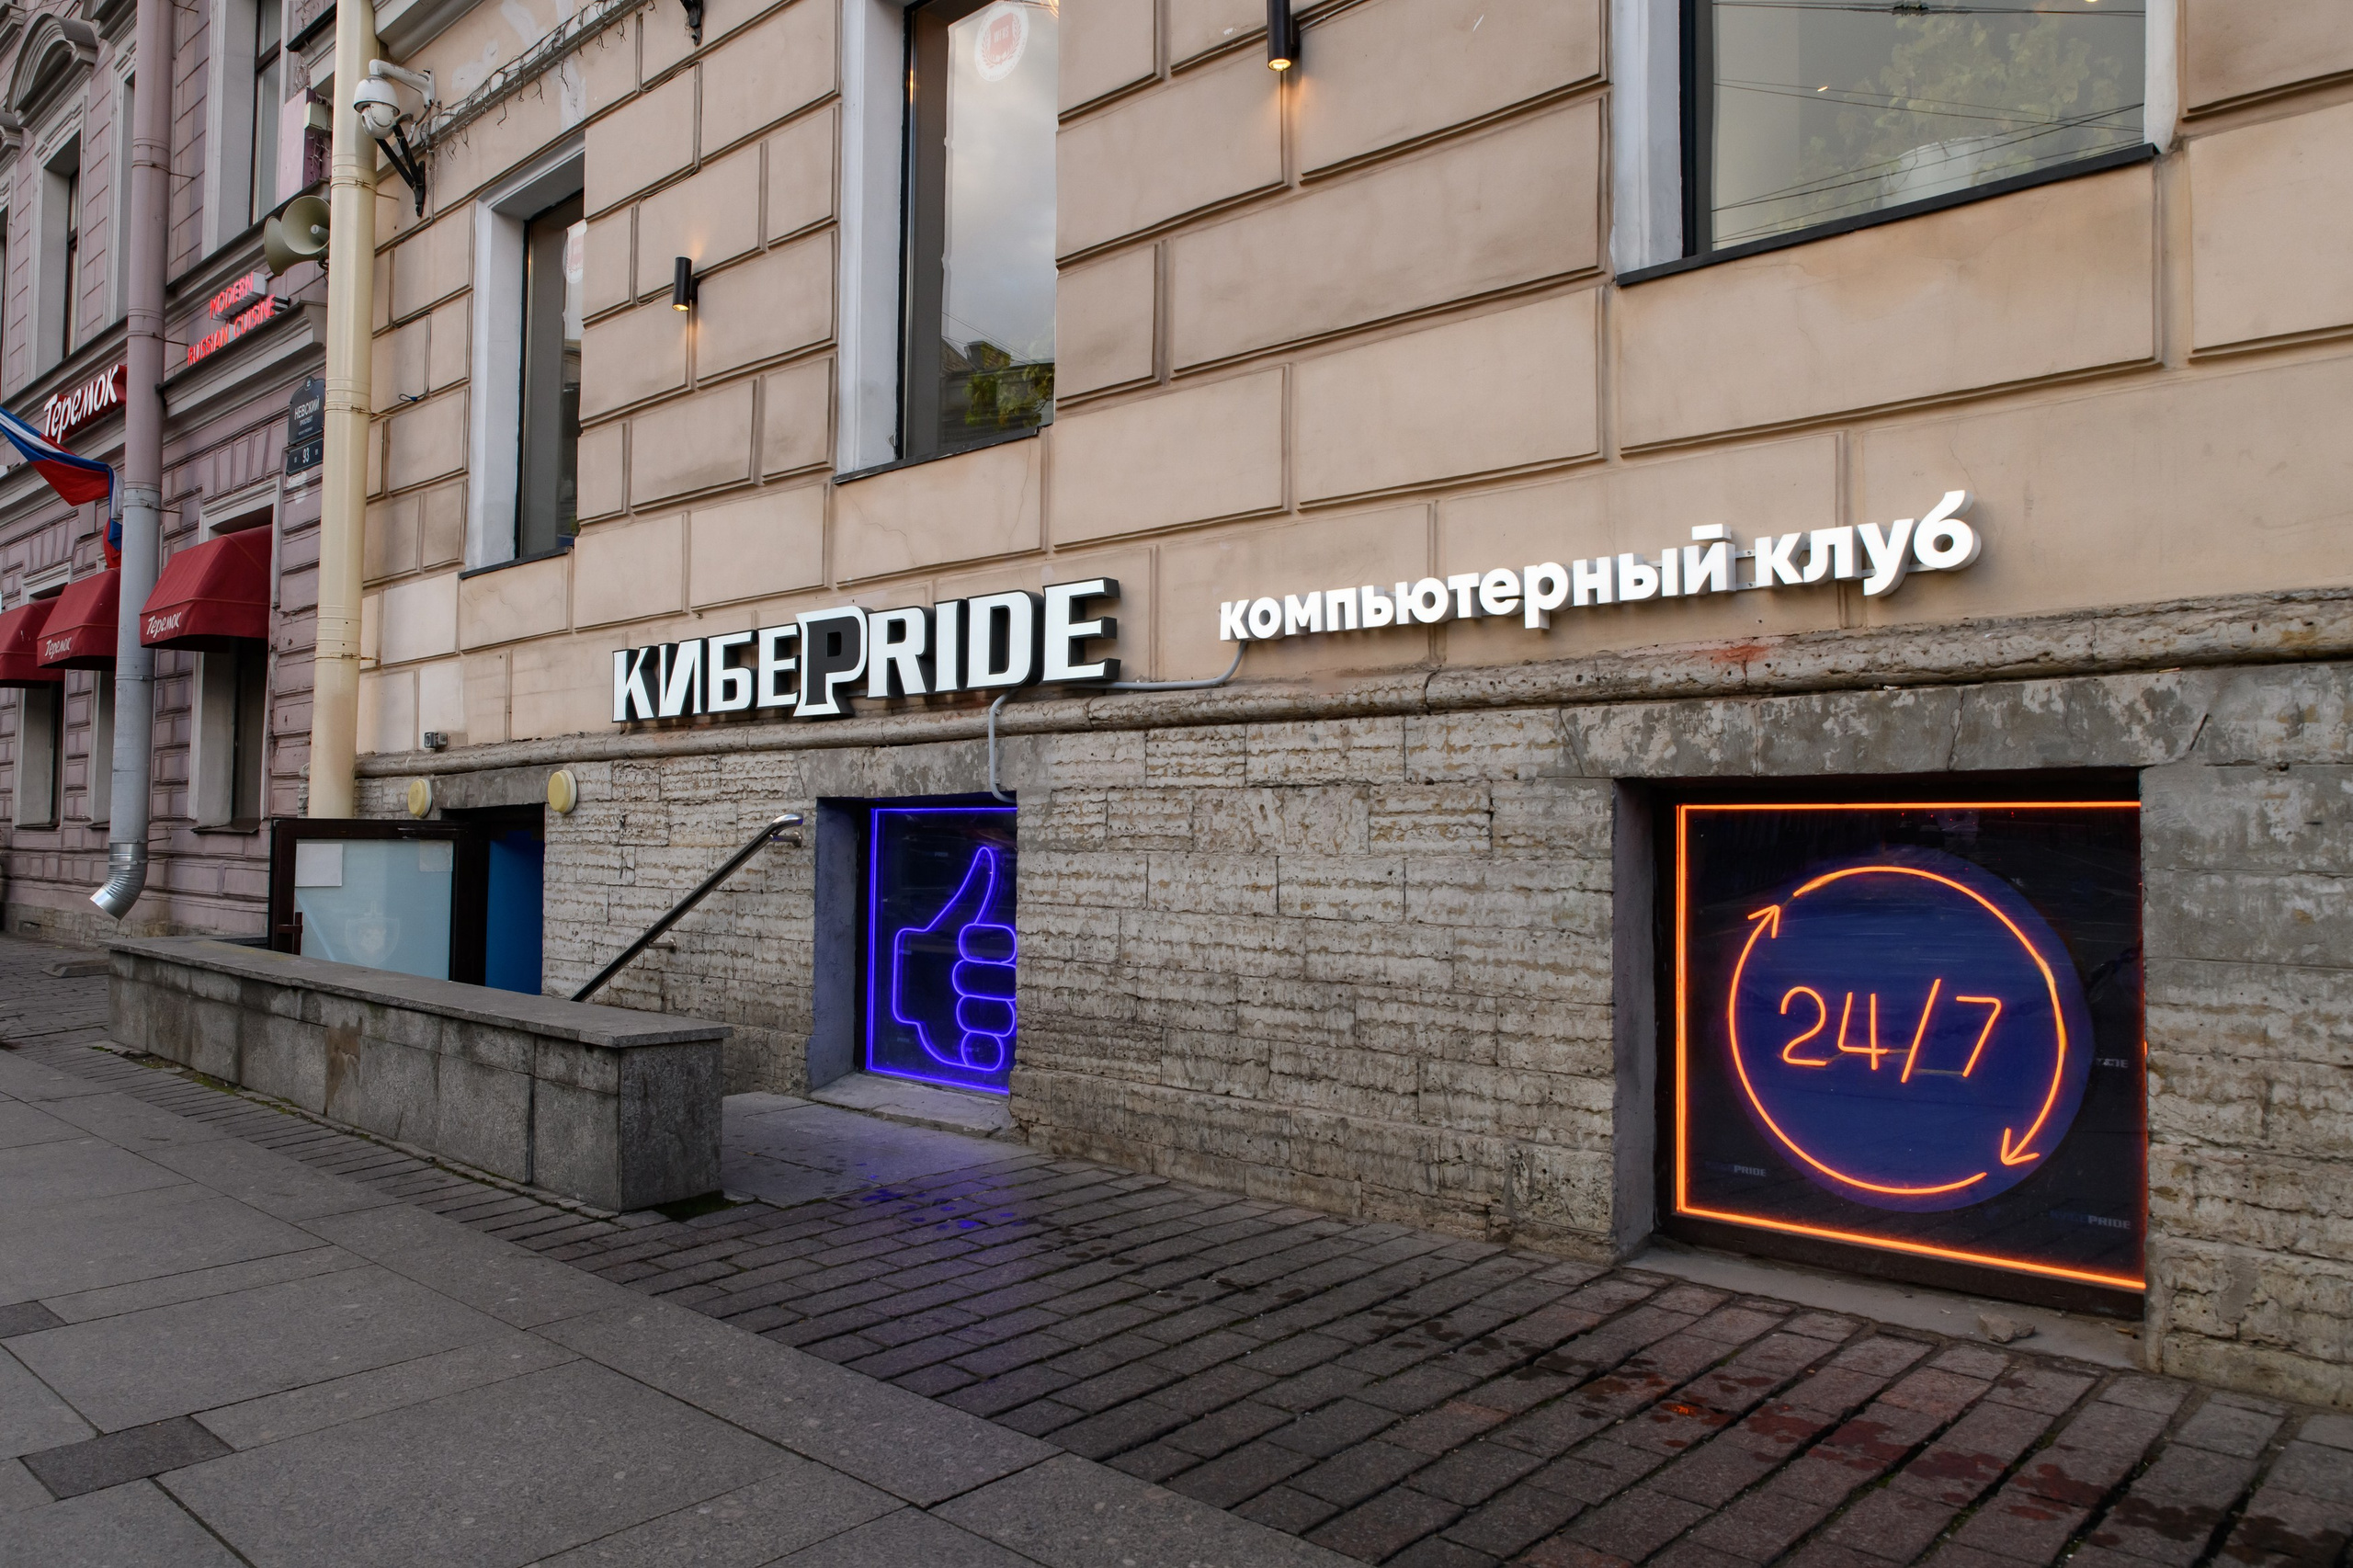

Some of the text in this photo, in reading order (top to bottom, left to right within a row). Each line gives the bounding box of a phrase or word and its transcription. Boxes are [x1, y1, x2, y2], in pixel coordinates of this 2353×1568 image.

[210, 271, 254, 320] MODERN
[188, 294, 276, 367] RUSSIAN CUISINE
[43, 364, 119, 445] Теремок
[294, 395, 320, 421] НЕВСКИЙ
[302, 447, 310, 464] 93
[1219, 489, 1981, 630] компьютерный клуб
[45, 636, 73, 659] Теремок
[146, 612, 182, 639] Теремок
[1779, 977, 2003, 1085] 24/7
